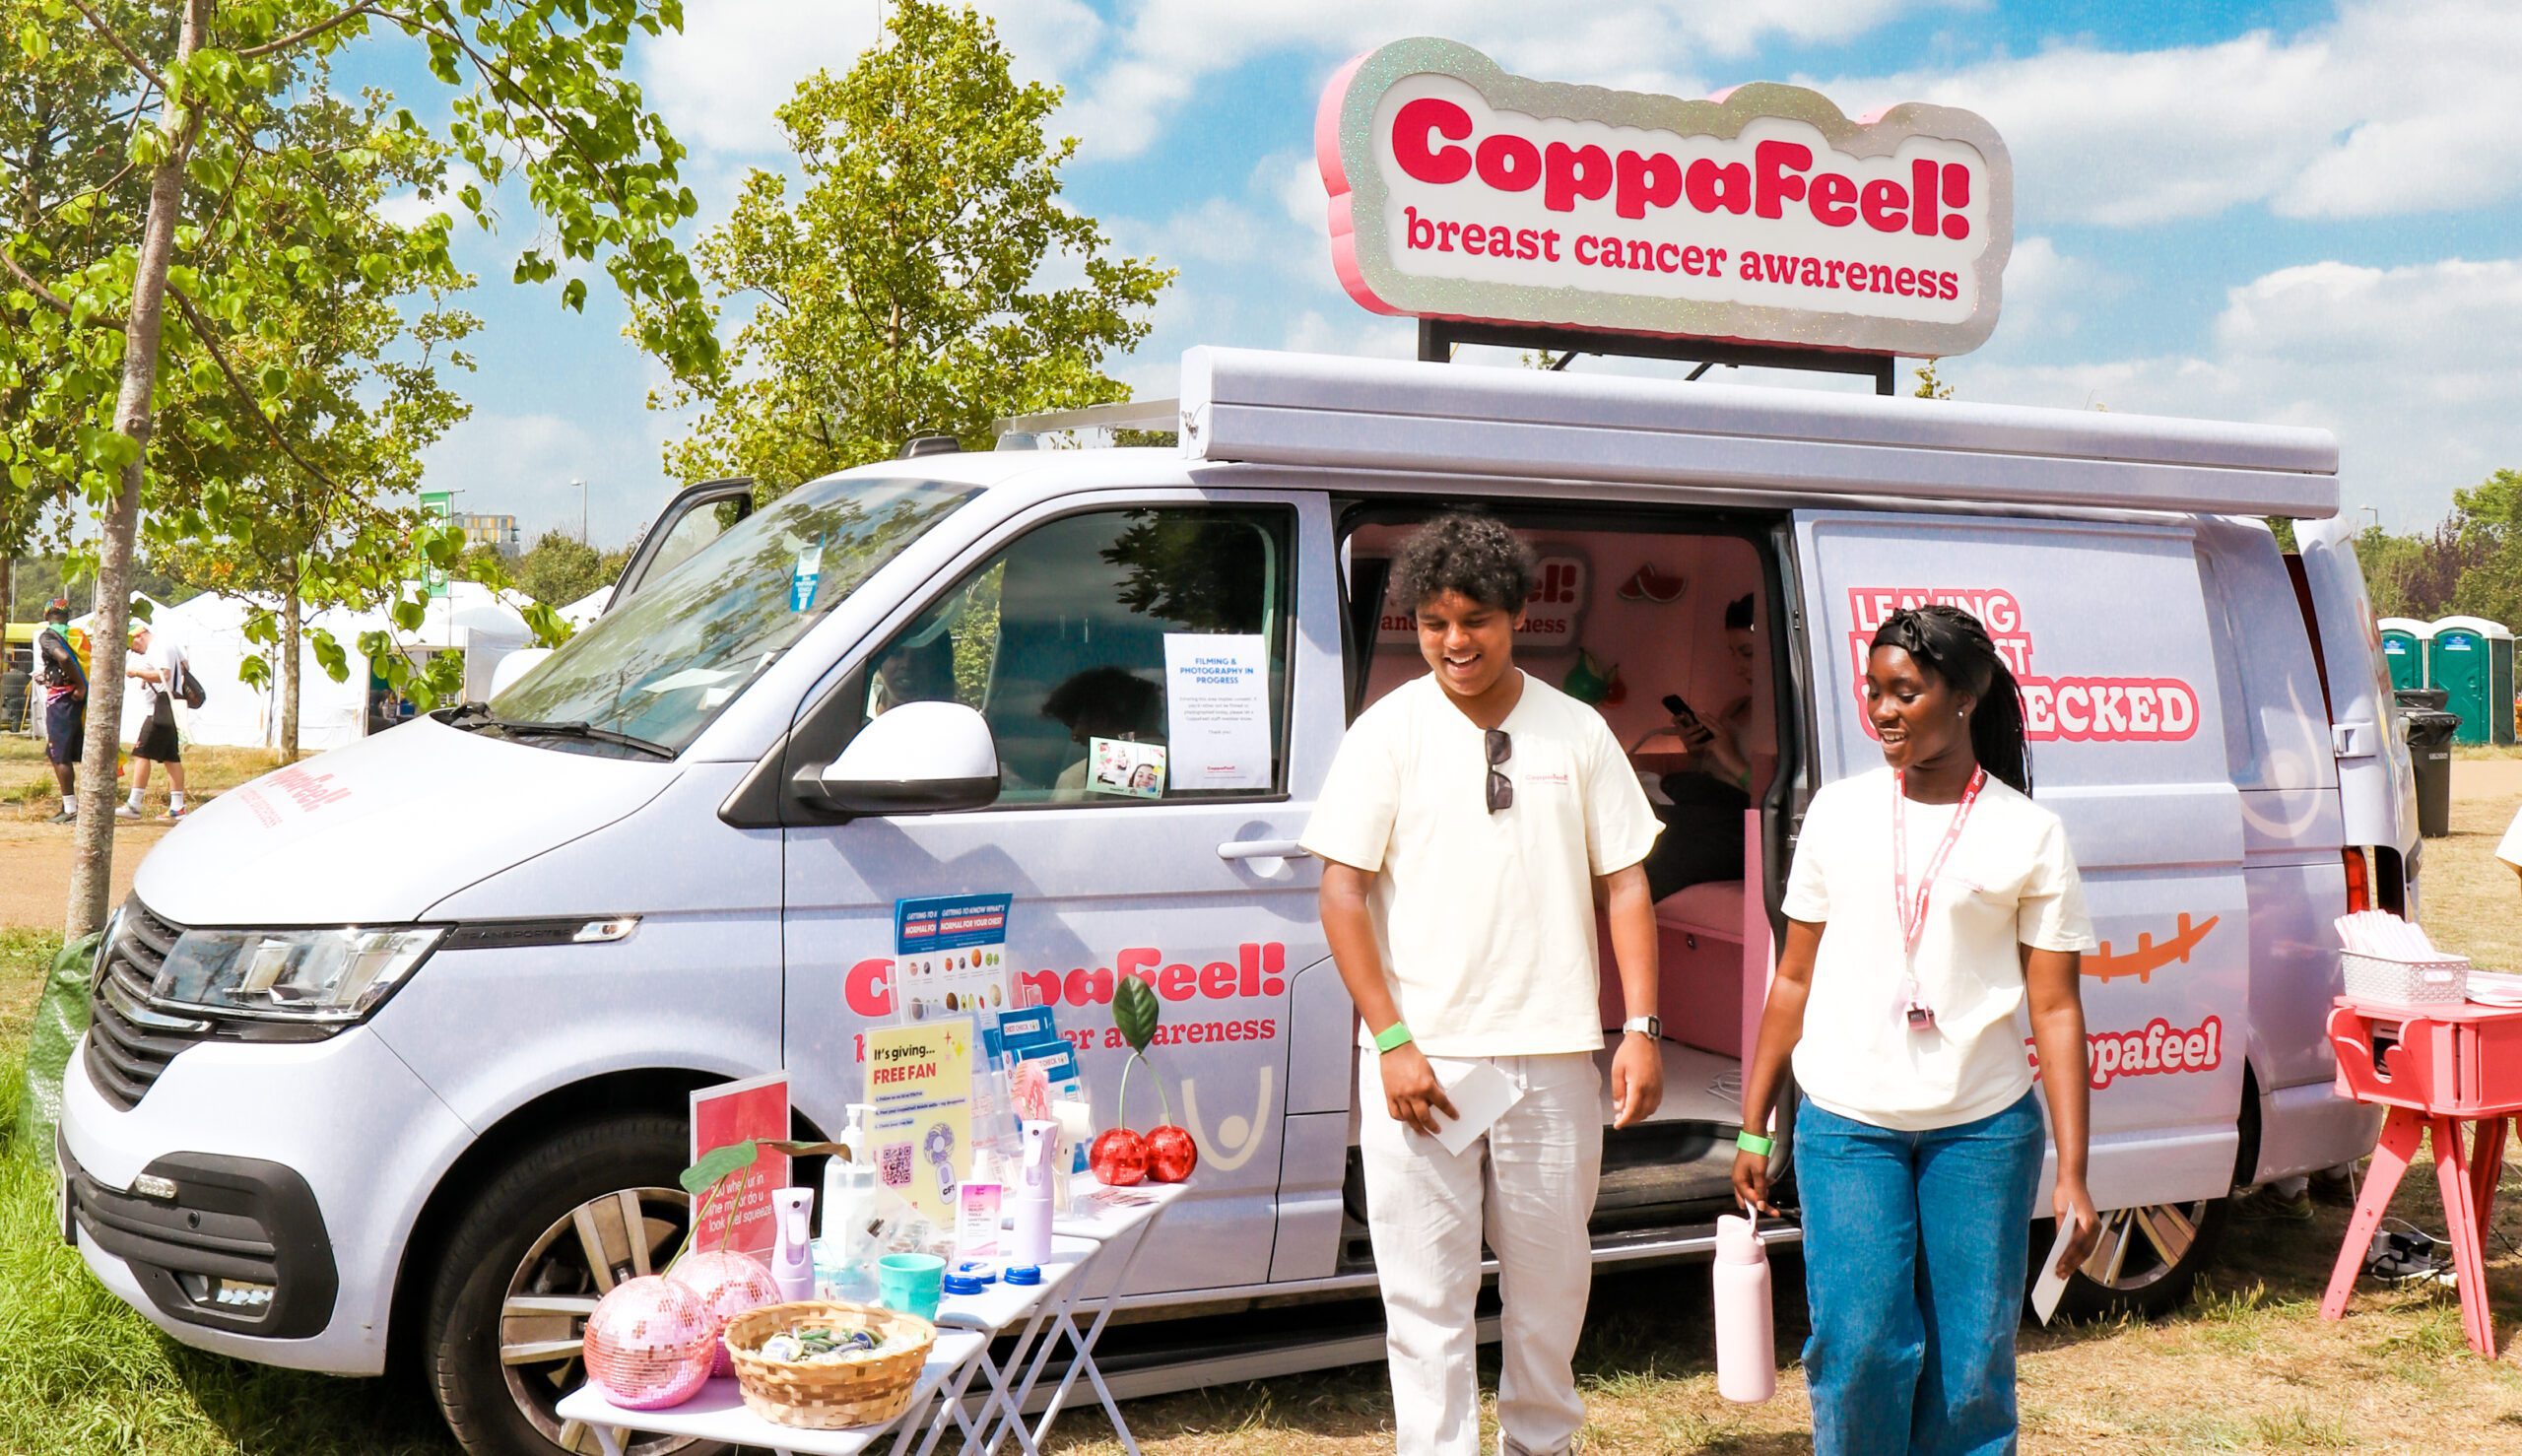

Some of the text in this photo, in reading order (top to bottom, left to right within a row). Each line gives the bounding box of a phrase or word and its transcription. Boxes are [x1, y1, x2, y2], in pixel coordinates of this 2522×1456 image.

[1392, 98, 1969, 240] CoppaFeel!
[1406, 206, 1959, 301] breast cancer awareness
[461, 929, 572, 940] TRANSPORTER
[905, 924, 927, 935] NORMAL
[941, 920, 963, 931] NORMAL
[963, 919, 973, 929] FOR
[974, 918, 987, 927] YOUR
[845, 942, 1285, 1018] CpaFeel!
[1104, 1017, 1276, 1049] aareness
[874, 1044, 935, 1062] It's giving...
[874, 1062, 937, 1085] FREE FAN
[748, 1176, 756, 1188] ur
[757, 1172, 764, 1184] in
[709, 1202, 723, 1214] the
[748, 1191, 758, 1205] do
[759, 1191, 763, 1202] u
[709, 1216, 725, 1232] look
[743, 1205, 772, 1224] squeeze
